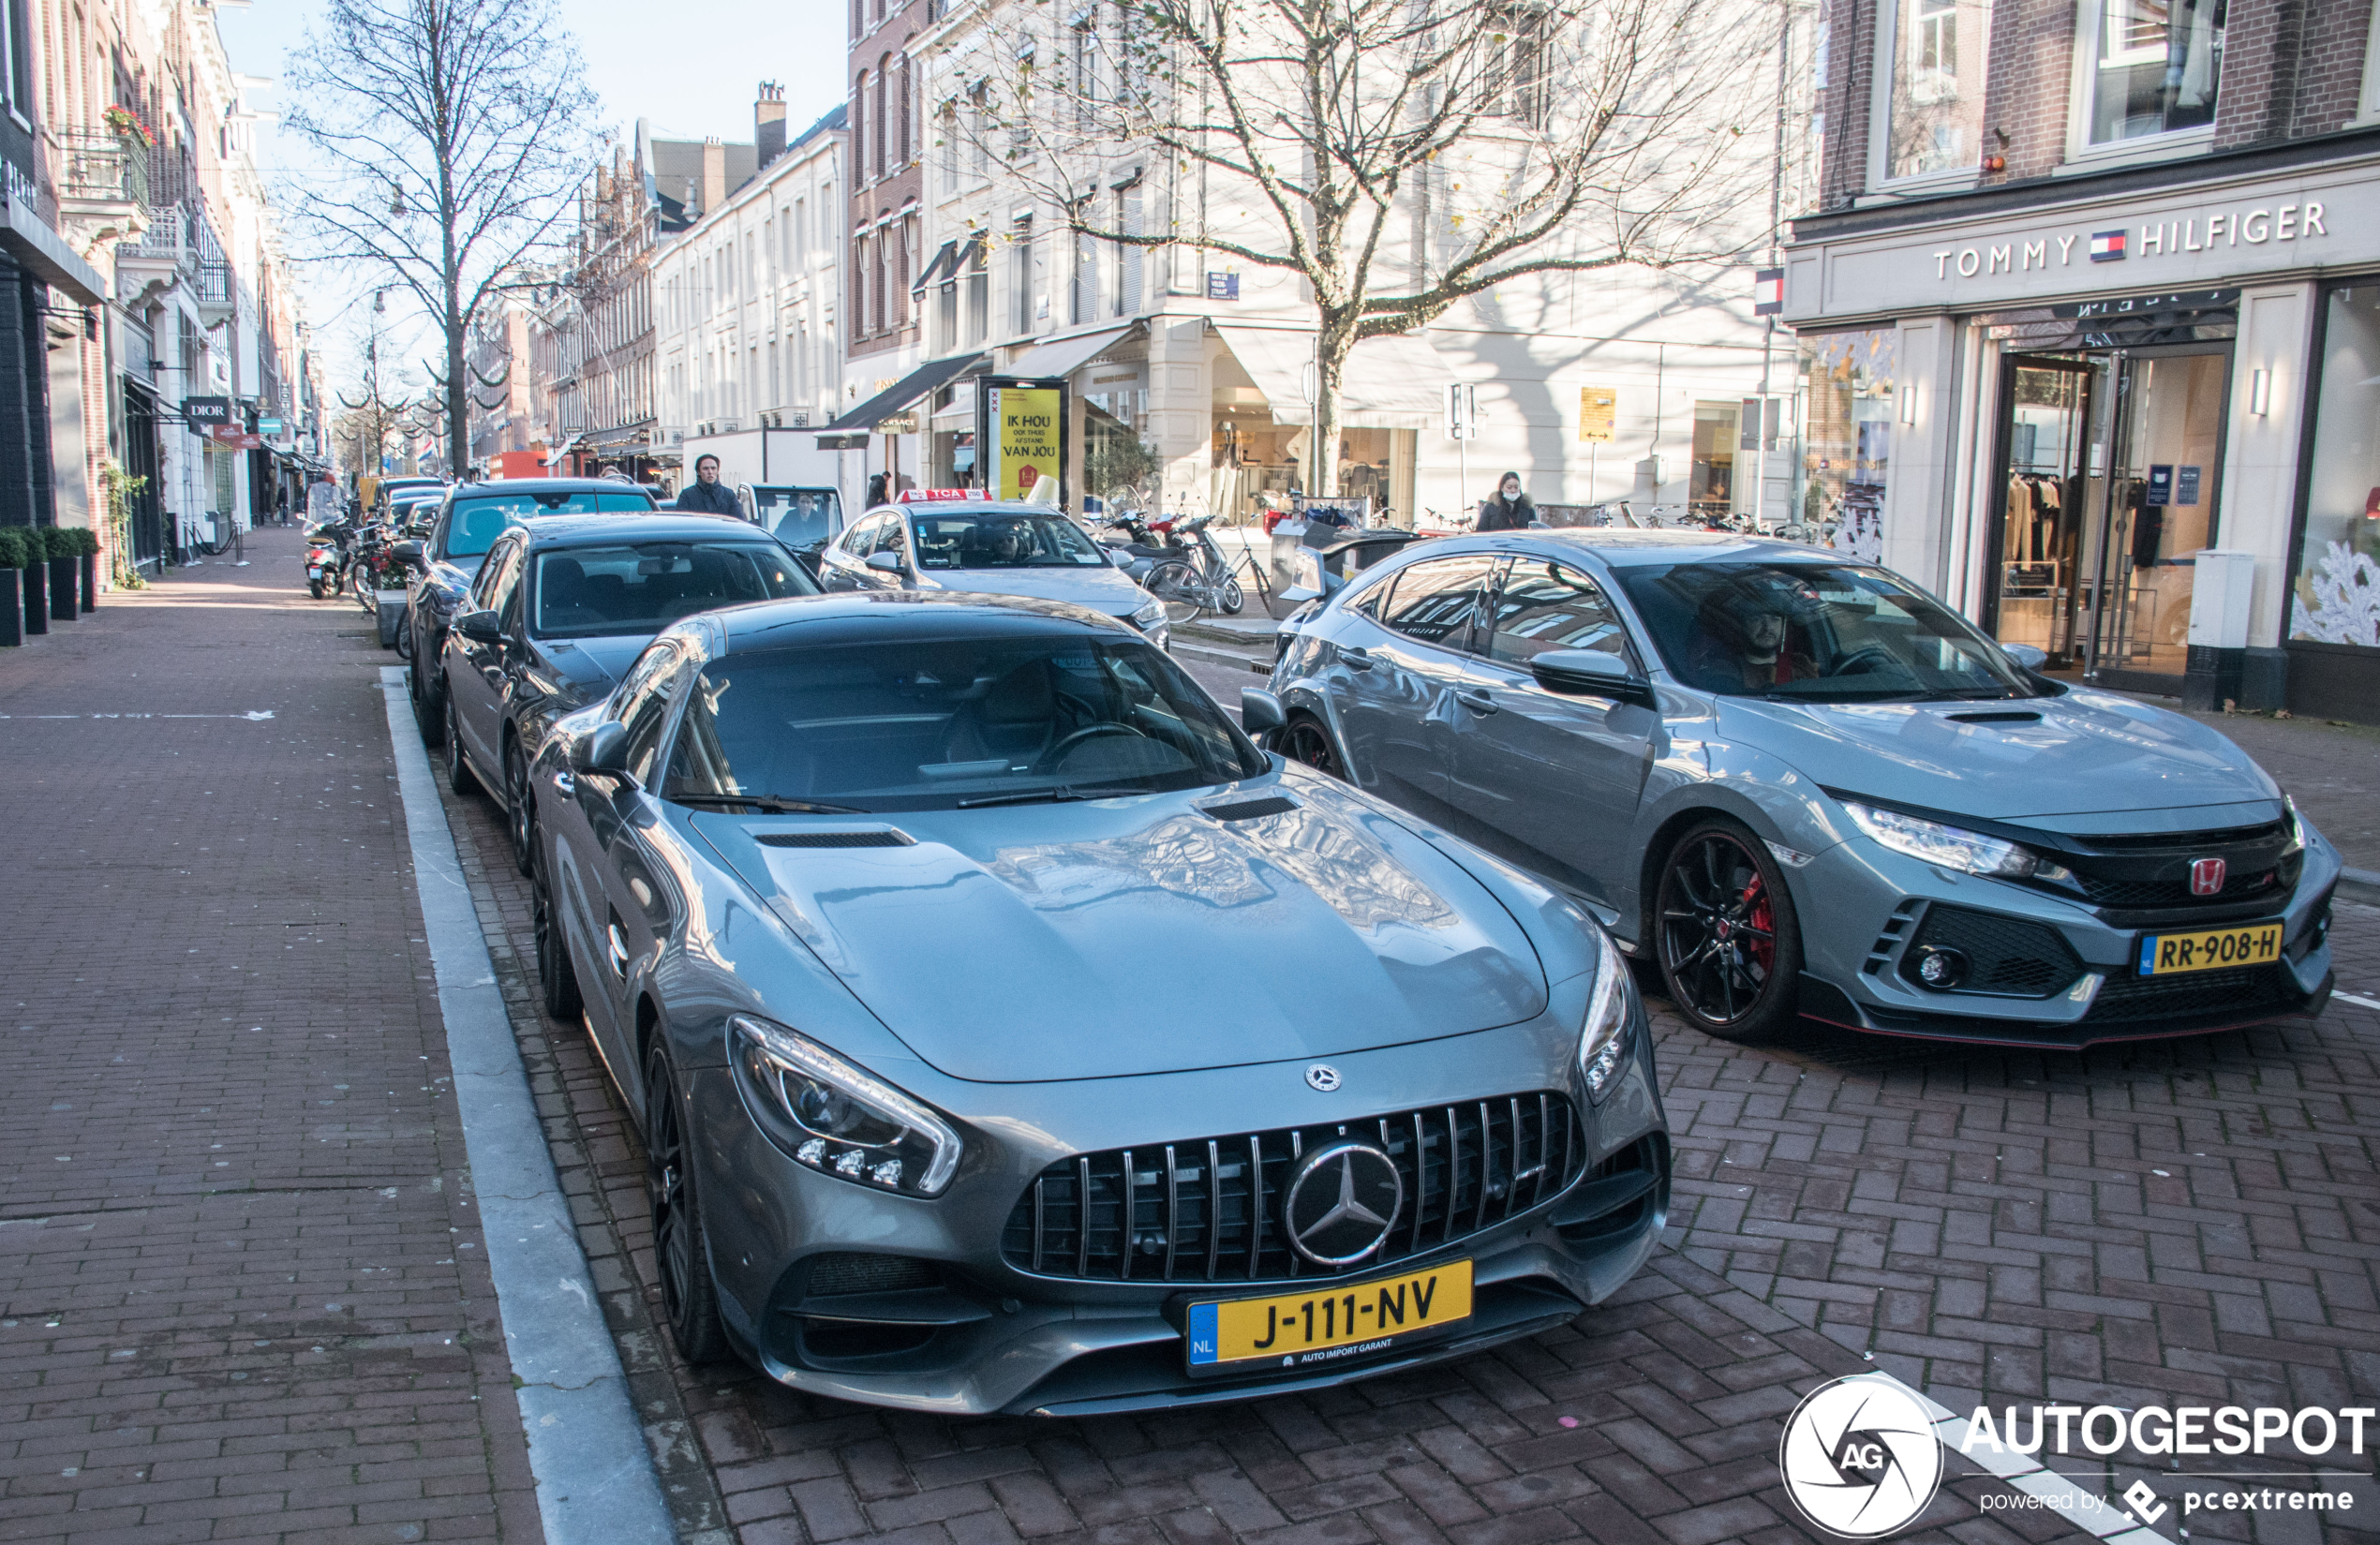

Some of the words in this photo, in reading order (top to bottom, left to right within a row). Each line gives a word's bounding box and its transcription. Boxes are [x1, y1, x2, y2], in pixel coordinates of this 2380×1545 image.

[1933, 233, 2077, 279] TOMMY
[2140, 202, 2328, 256] HILFIGER
[190, 405, 225, 416] DIOR
[281, 383, 290, 425] HOTEL
[1007, 415, 1019, 427] IK
[1022, 415, 1050, 427] HOU
[1003, 446, 1030, 457] VAN
[1032, 446, 1055, 457] JOU
[932, 489, 960, 498] TCA
[2161, 929, 2276, 968] RR-908-H
[1254, 1275, 1436, 1348] J-111-NV
[1193, 1340, 1213, 1354] NL
[1301, 1350, 1325, 1363] AUTO
[1326, 1345, 1357, 1359] IMPORT
[1359, 1338, 1392, 1355] GARANT
